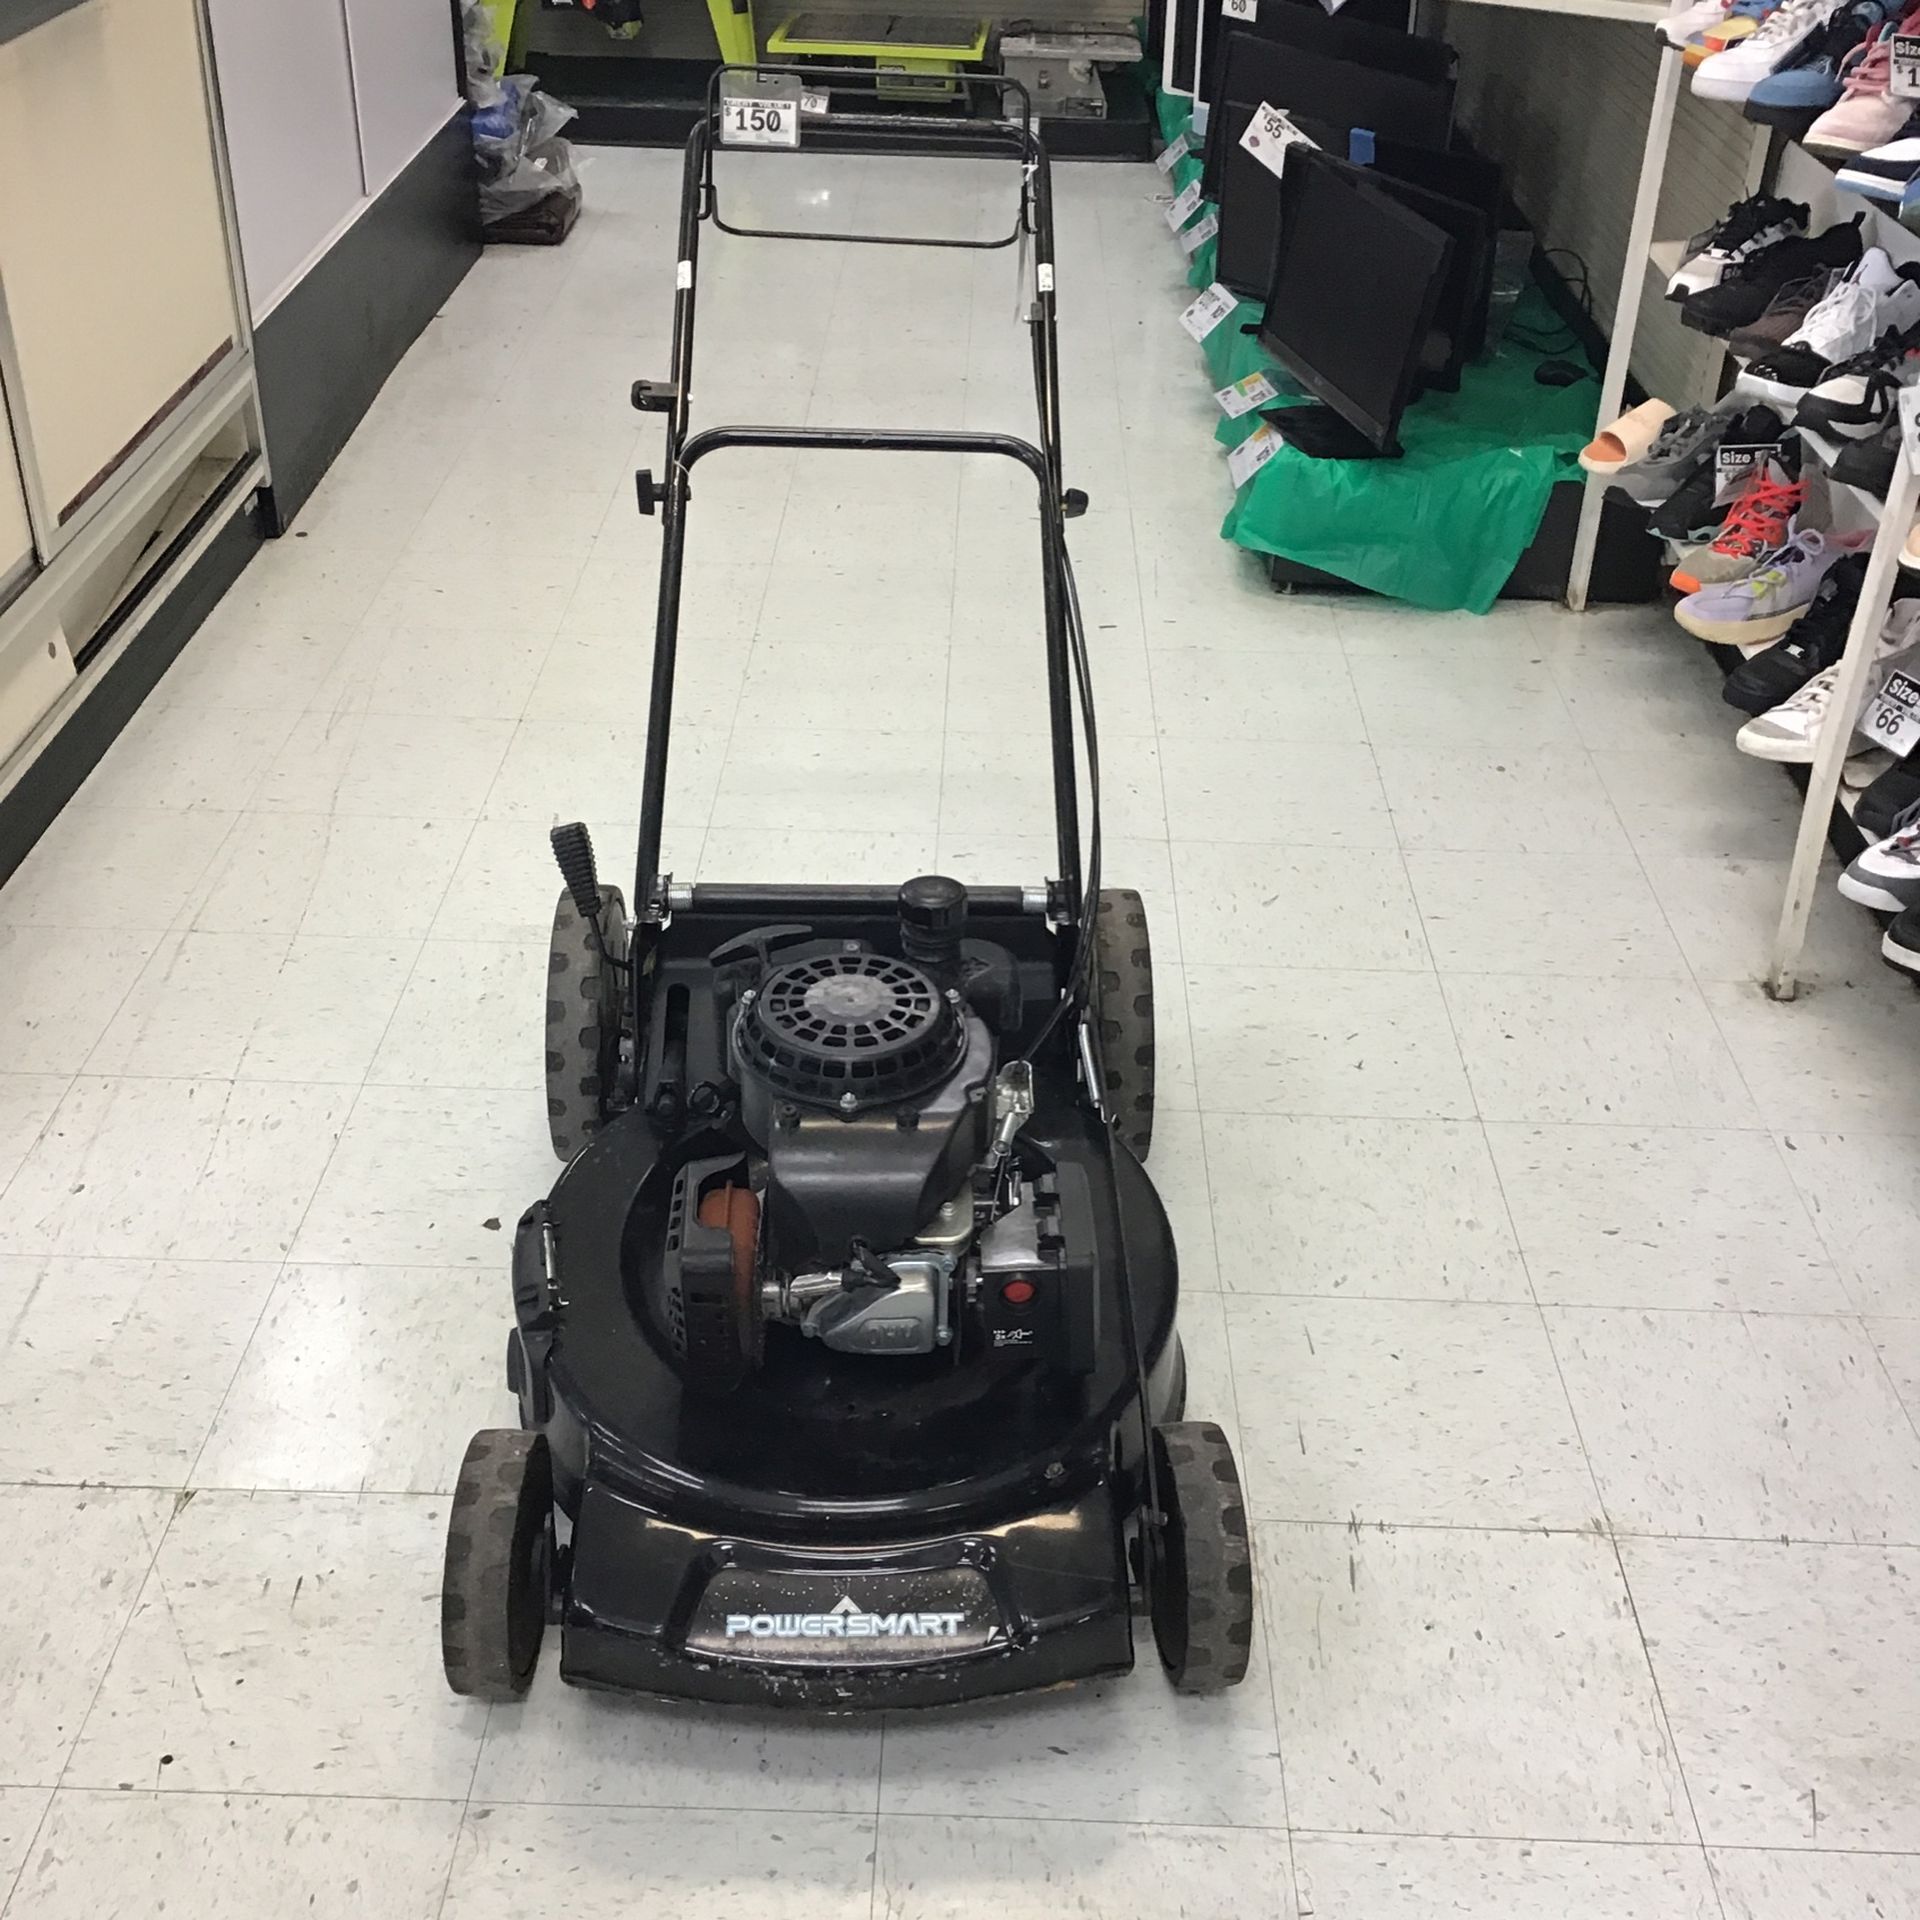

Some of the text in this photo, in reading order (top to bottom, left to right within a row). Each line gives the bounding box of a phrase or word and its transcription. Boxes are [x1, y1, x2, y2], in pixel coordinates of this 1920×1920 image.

[1722, 451, 1752, 464] Size
[1889, 677, 1919, 704] Size
[725, 1612, 965, 1638] POWERSMART
